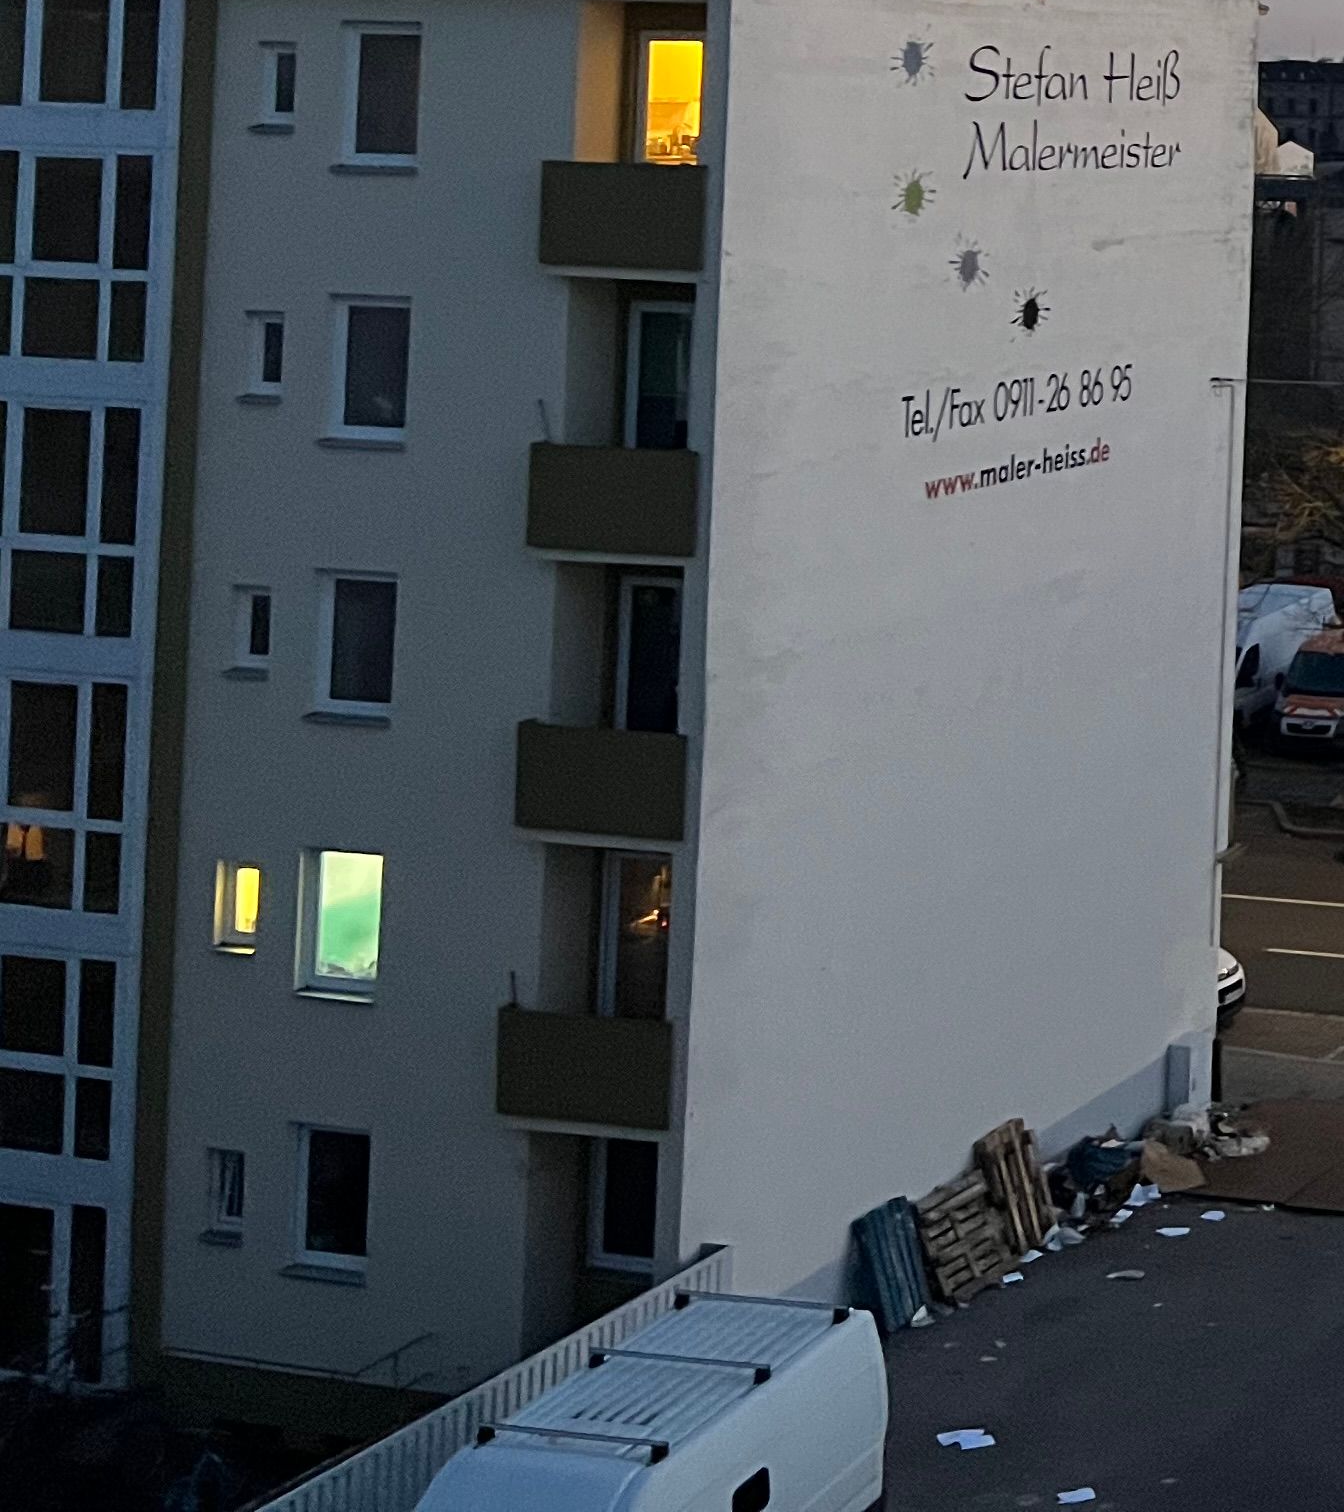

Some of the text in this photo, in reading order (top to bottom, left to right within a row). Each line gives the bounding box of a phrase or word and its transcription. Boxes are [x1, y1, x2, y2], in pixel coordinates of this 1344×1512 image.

[965, 45, 1180, 106] Stefan Heiß
[963, 119, 1182, 180] Malermeister
[902, 363, 1133, 443] Tel./Fax 0911-26 86 95
[924, 437, 1111, 499] www.maler-heiss.de
